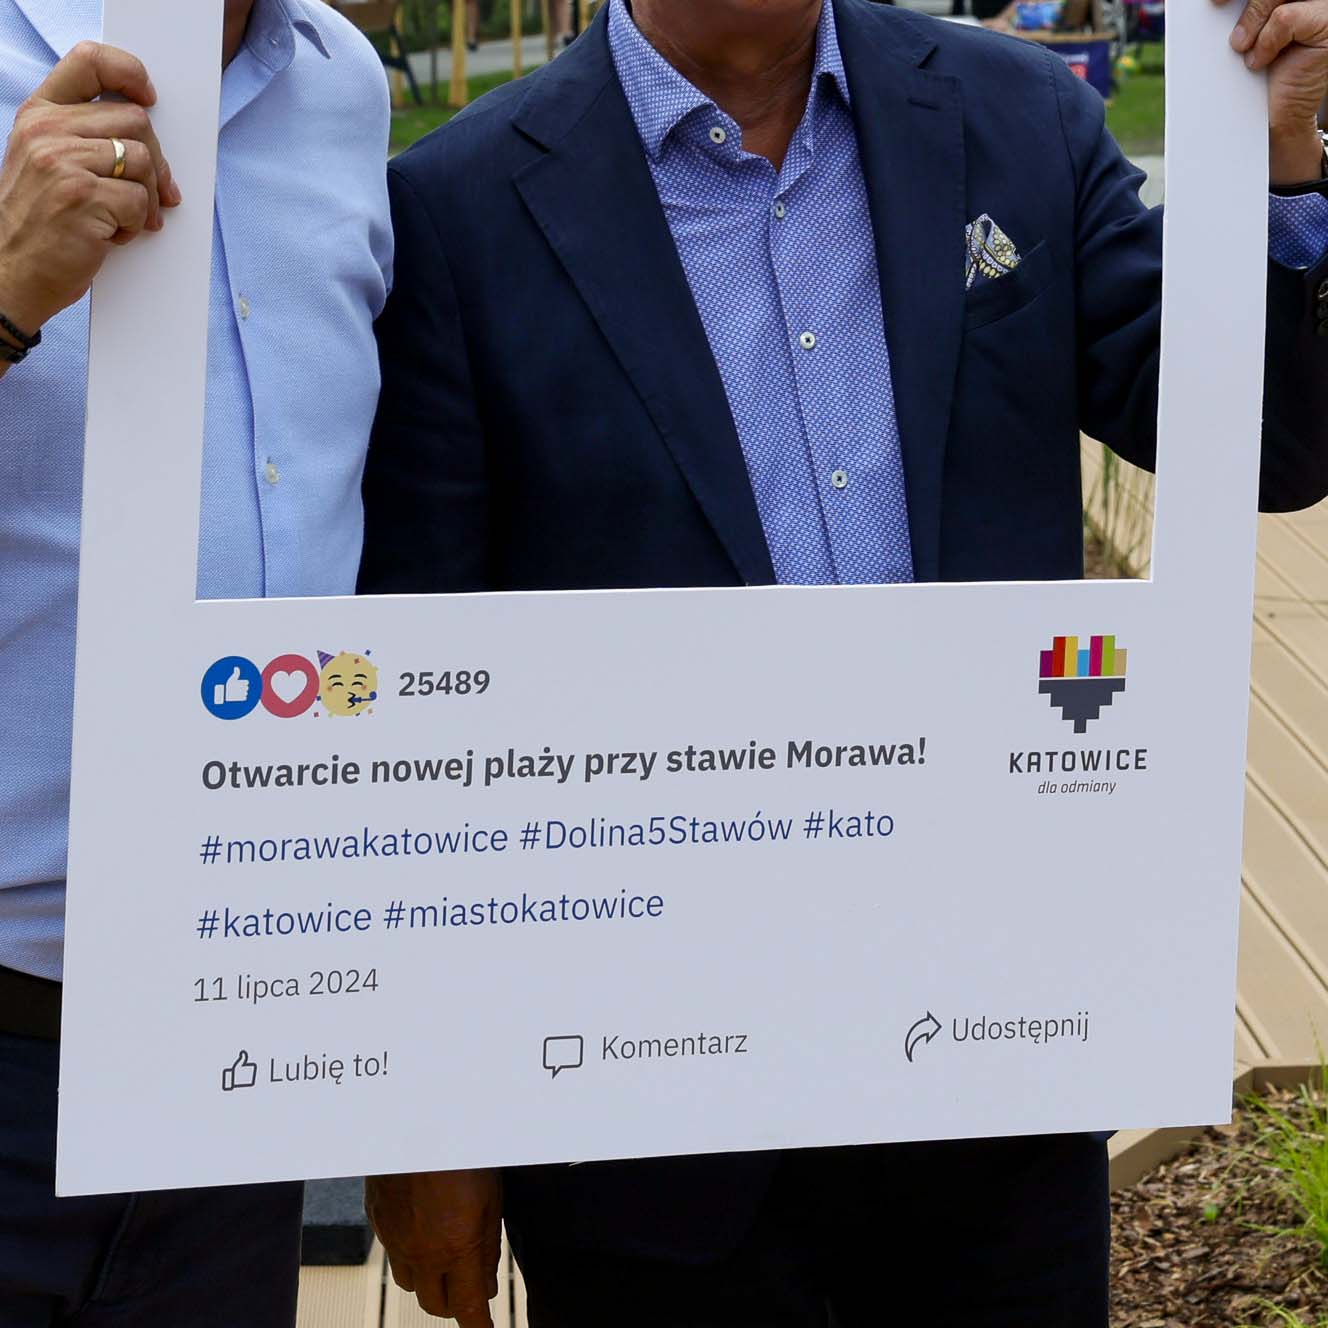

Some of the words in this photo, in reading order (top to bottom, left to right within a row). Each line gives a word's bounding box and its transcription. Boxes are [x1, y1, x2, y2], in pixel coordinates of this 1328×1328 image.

[398, 669, 491, 697] 25489
[201, 753, 361, 791] Otwarcie
[371, 749, 474, 788] nowej
[484, 746, 576, 787] plaży
[584, 751, 658, 784] przy
[665, 739, 777, 773] stawie
[786, 735, 927, 769] Morawa!
[1009, 748, 1148, 774] KATOWICE
[1037, 780, 1059, 795] dla
[1061, 778, 1118, 796] odmiany
[199, 822, 509, 865] #morawakatowice
[519, 810, 793, 851] #Dolina5Stawów
[802, 808, 895, 840] #kato
[195, 901, 372, 940] #katowice
[383, 888, 664, 930] #miastokatowice
[193, 976, 228, 1003] 11
[237, 973, 301, 1006] lipca
[308, 967, 380, 996] 2024
[602, 1032, 748, 1061] Komentarz
[952, 1010, 1090, 1048] Udostępnij
[269, 1052, 345, 1086] Lubię
[352, 1050, 390, 1079] to!
